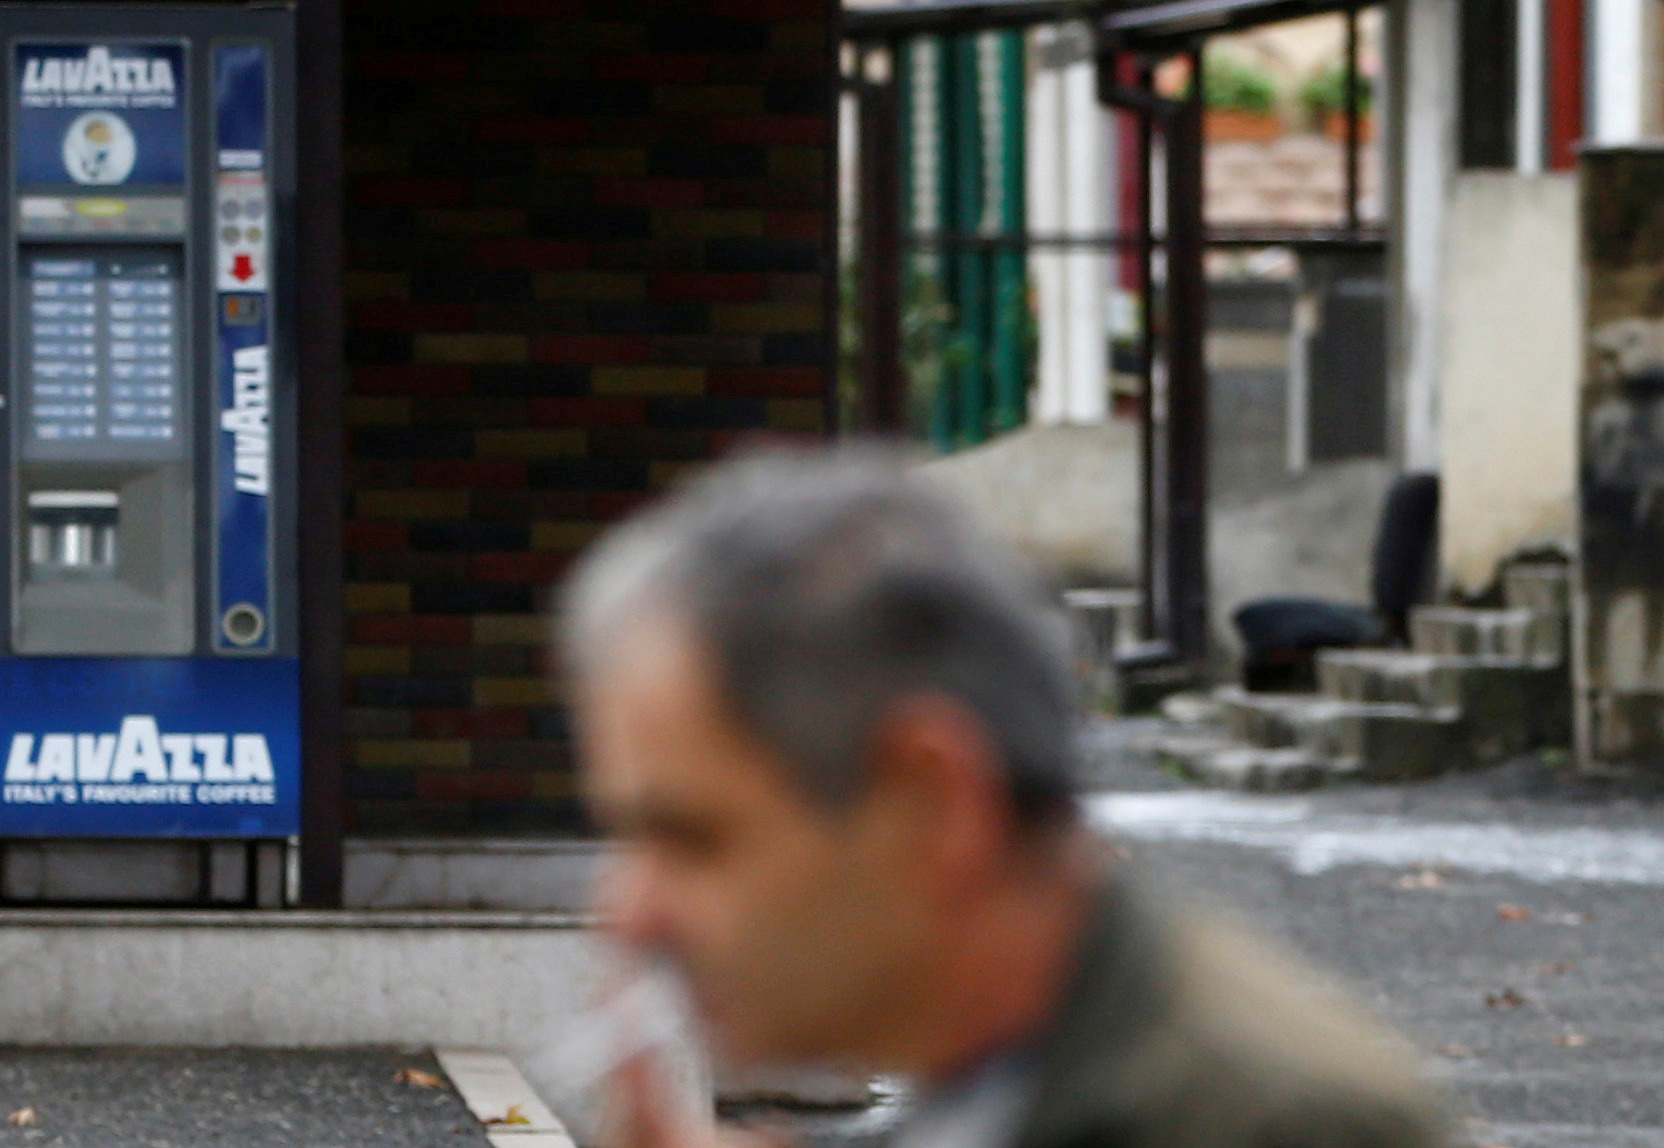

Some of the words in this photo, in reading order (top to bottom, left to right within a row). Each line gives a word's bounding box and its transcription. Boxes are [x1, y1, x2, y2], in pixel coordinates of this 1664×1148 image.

[21, 46, 175, 91] LAVAZZA
[221, 345, 269, 496] LAVAZZA
[4, 715, 275, 782] LAVAZZA
[196, 784, 276, 805] COFFEE
